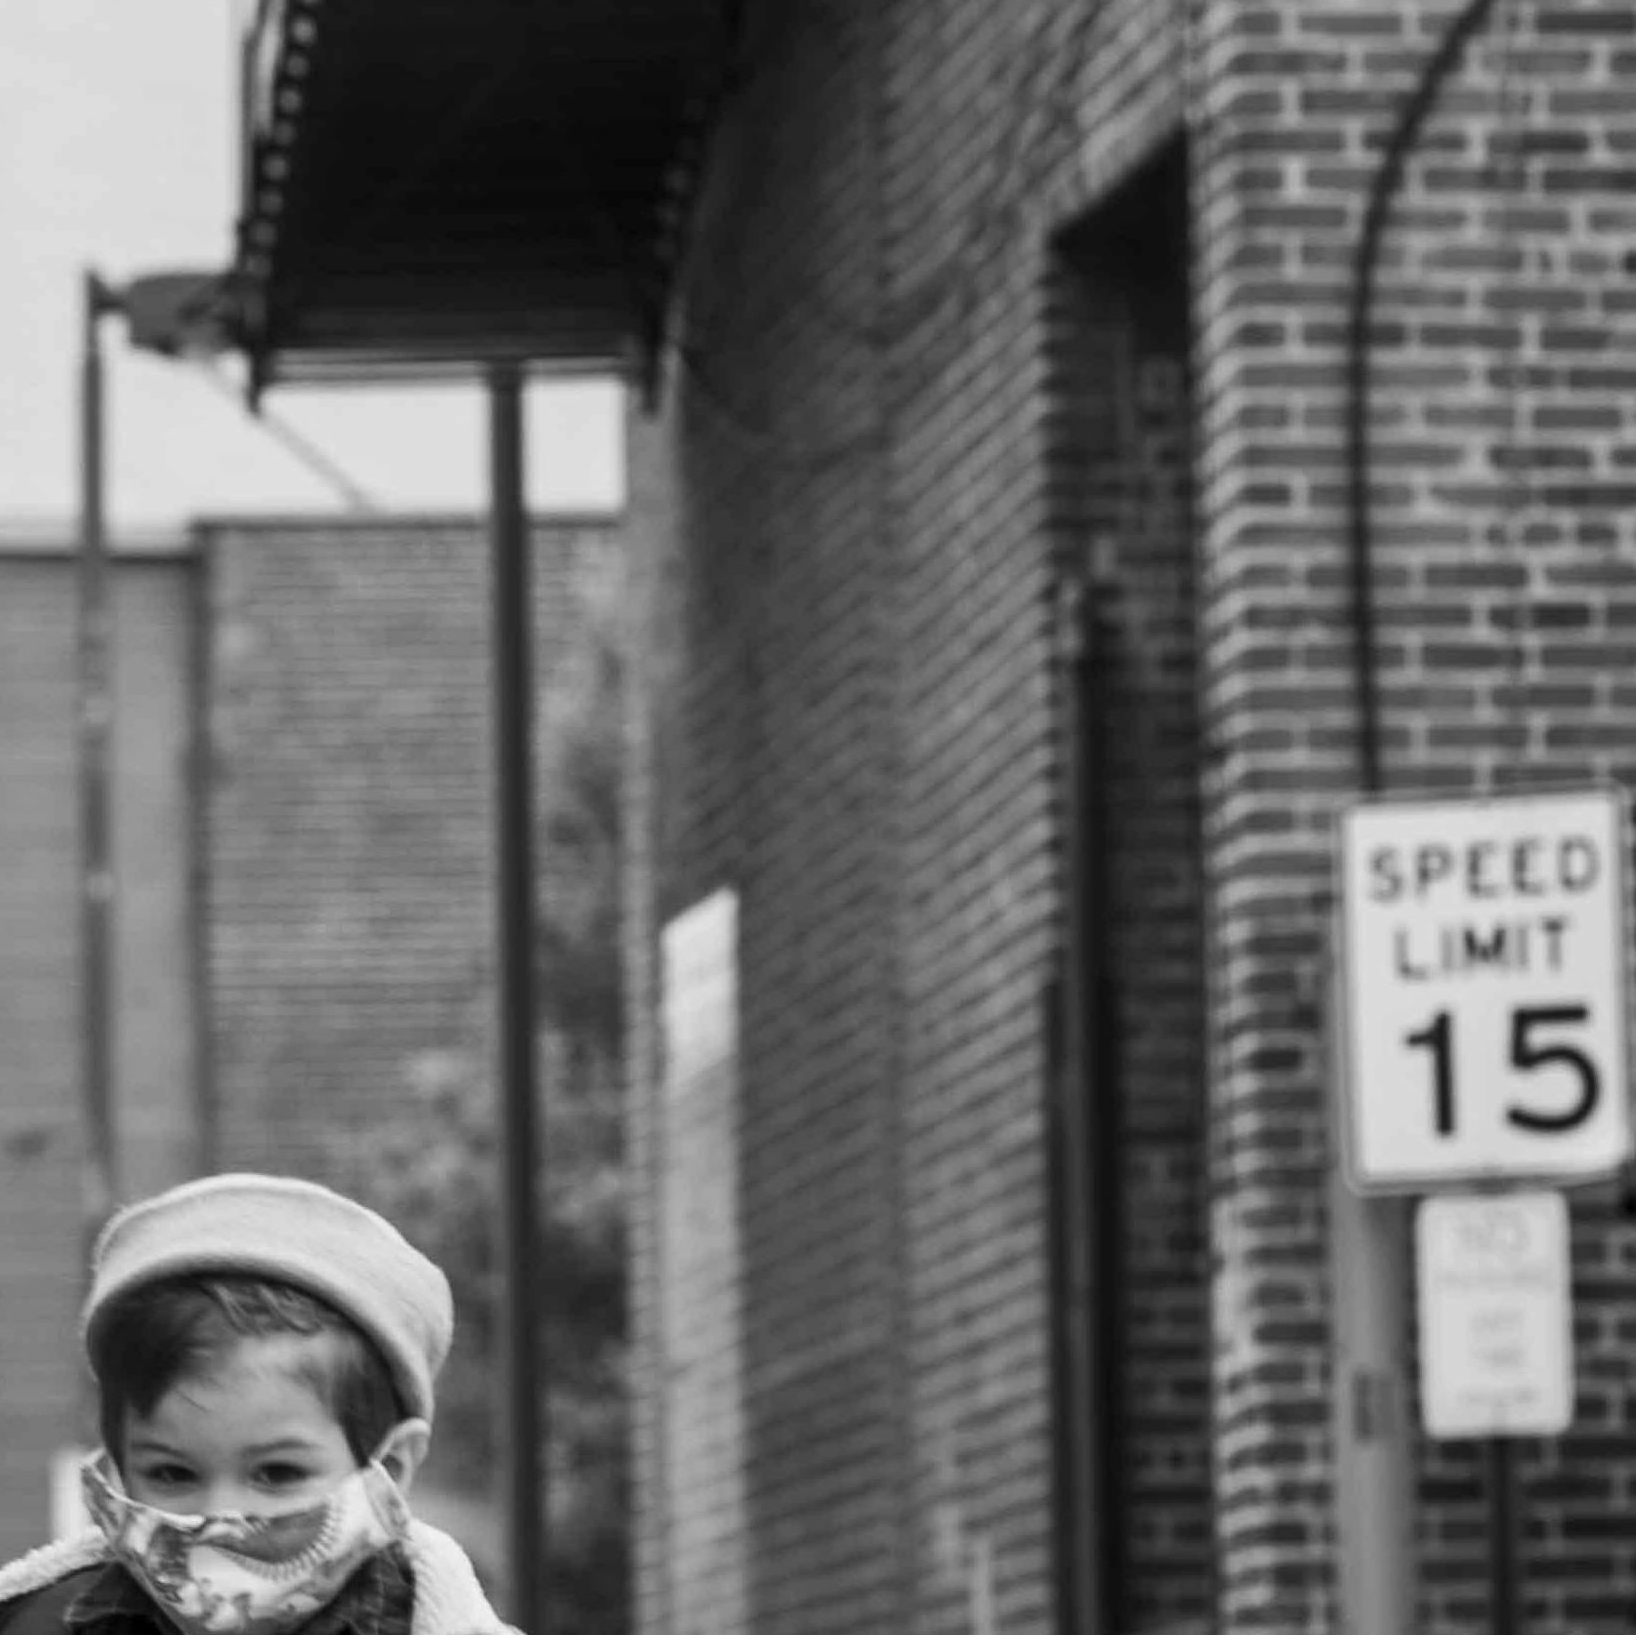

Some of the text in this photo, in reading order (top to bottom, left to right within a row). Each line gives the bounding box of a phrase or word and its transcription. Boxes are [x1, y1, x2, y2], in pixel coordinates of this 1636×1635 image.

[1365, 835, 1599, 903] SPEED
[1394, 916, 1567, 979] LIMIT
[1405, 1004, 1600, 1137] 15
